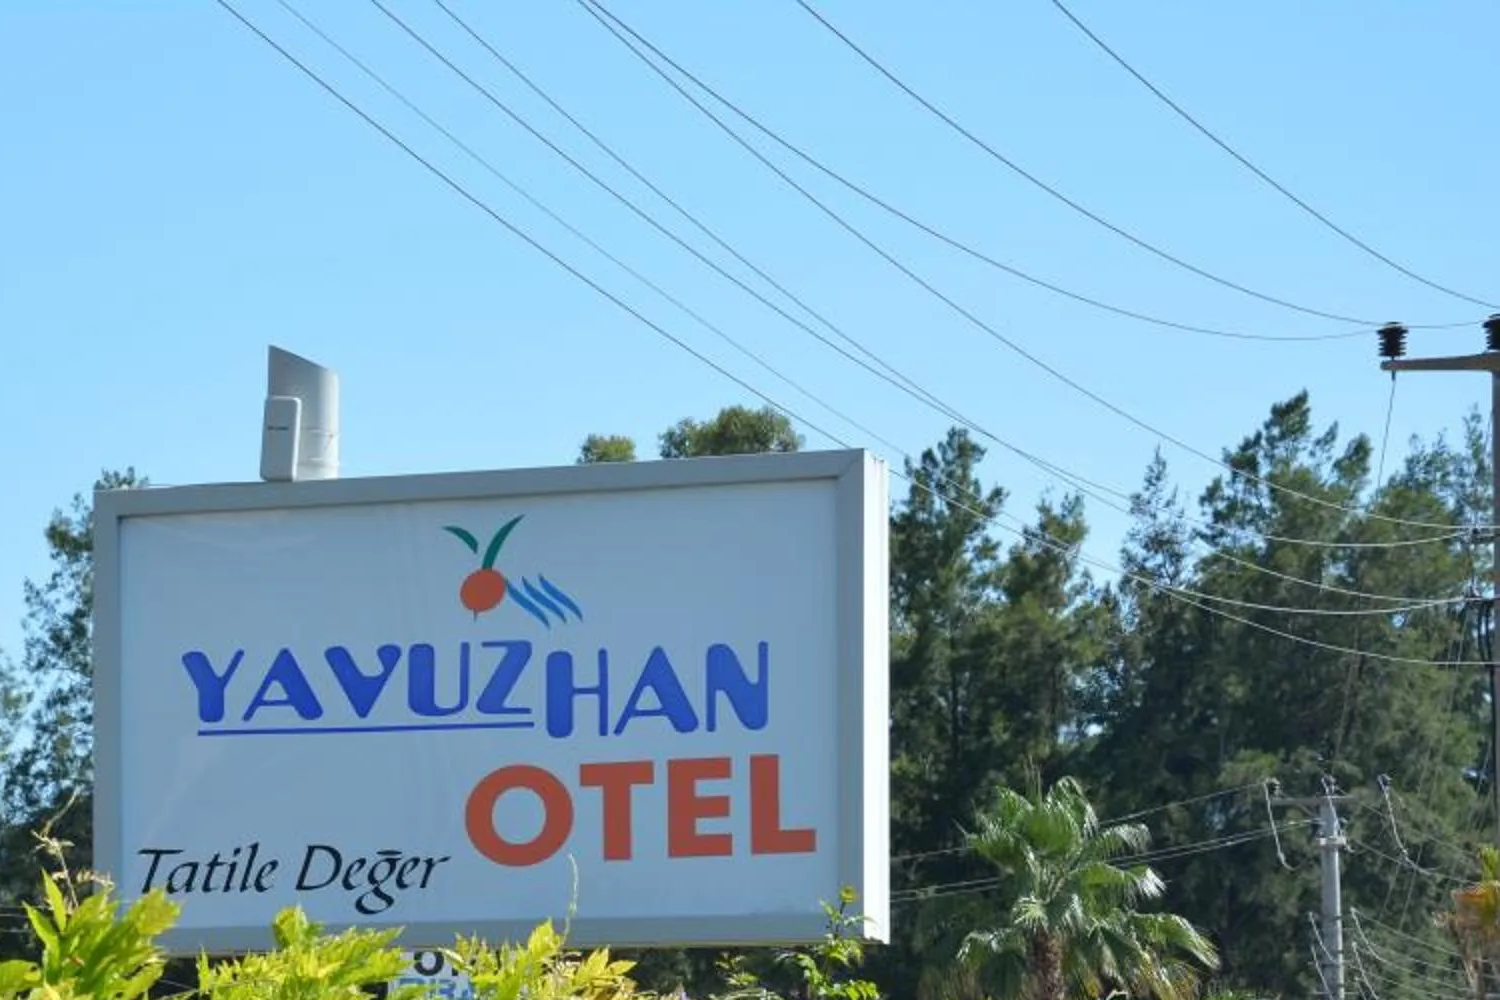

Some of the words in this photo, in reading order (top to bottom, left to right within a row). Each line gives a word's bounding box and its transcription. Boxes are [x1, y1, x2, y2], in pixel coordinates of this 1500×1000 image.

[181, 640, 770, 739] YAVUZHAN
[465, 754, 817, 866] OTEL
[137, 842, 279, 895] Tatile
